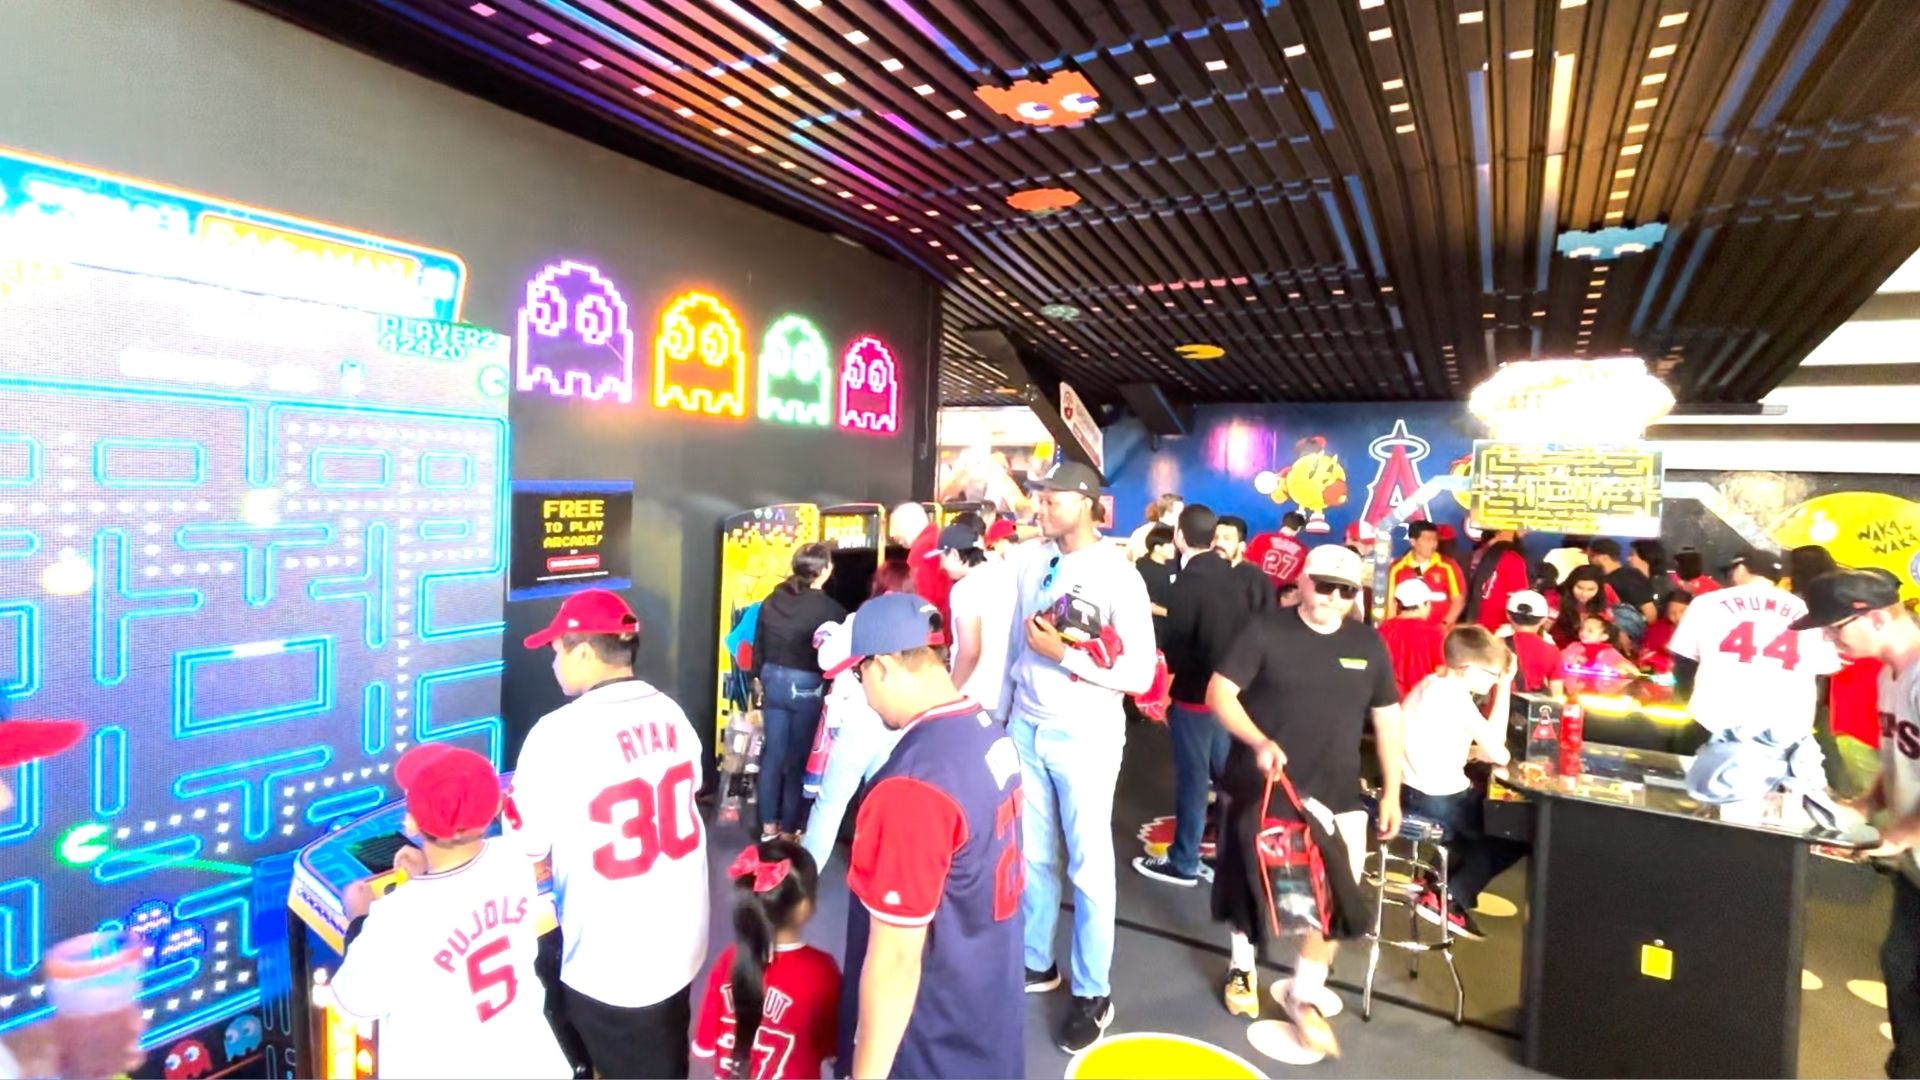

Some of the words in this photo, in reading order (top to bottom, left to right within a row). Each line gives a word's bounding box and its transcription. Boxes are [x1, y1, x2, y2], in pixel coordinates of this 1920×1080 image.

[543, 500, 605, 519] FREE
[544, 521, 563, 534] TO
[569, 520, 604, 533] PLAY
[1262, 549, 1299, 580] 27
[1718, 620, 1801, 671] 44
[615, 721, 678, 764] RYAN
[589, 759, 701, 882] 30
[432, 895, 528, 974] PUJOLS
[466, 935, 519, 1023] 5
[719, 984, 794, 1024] TUT
